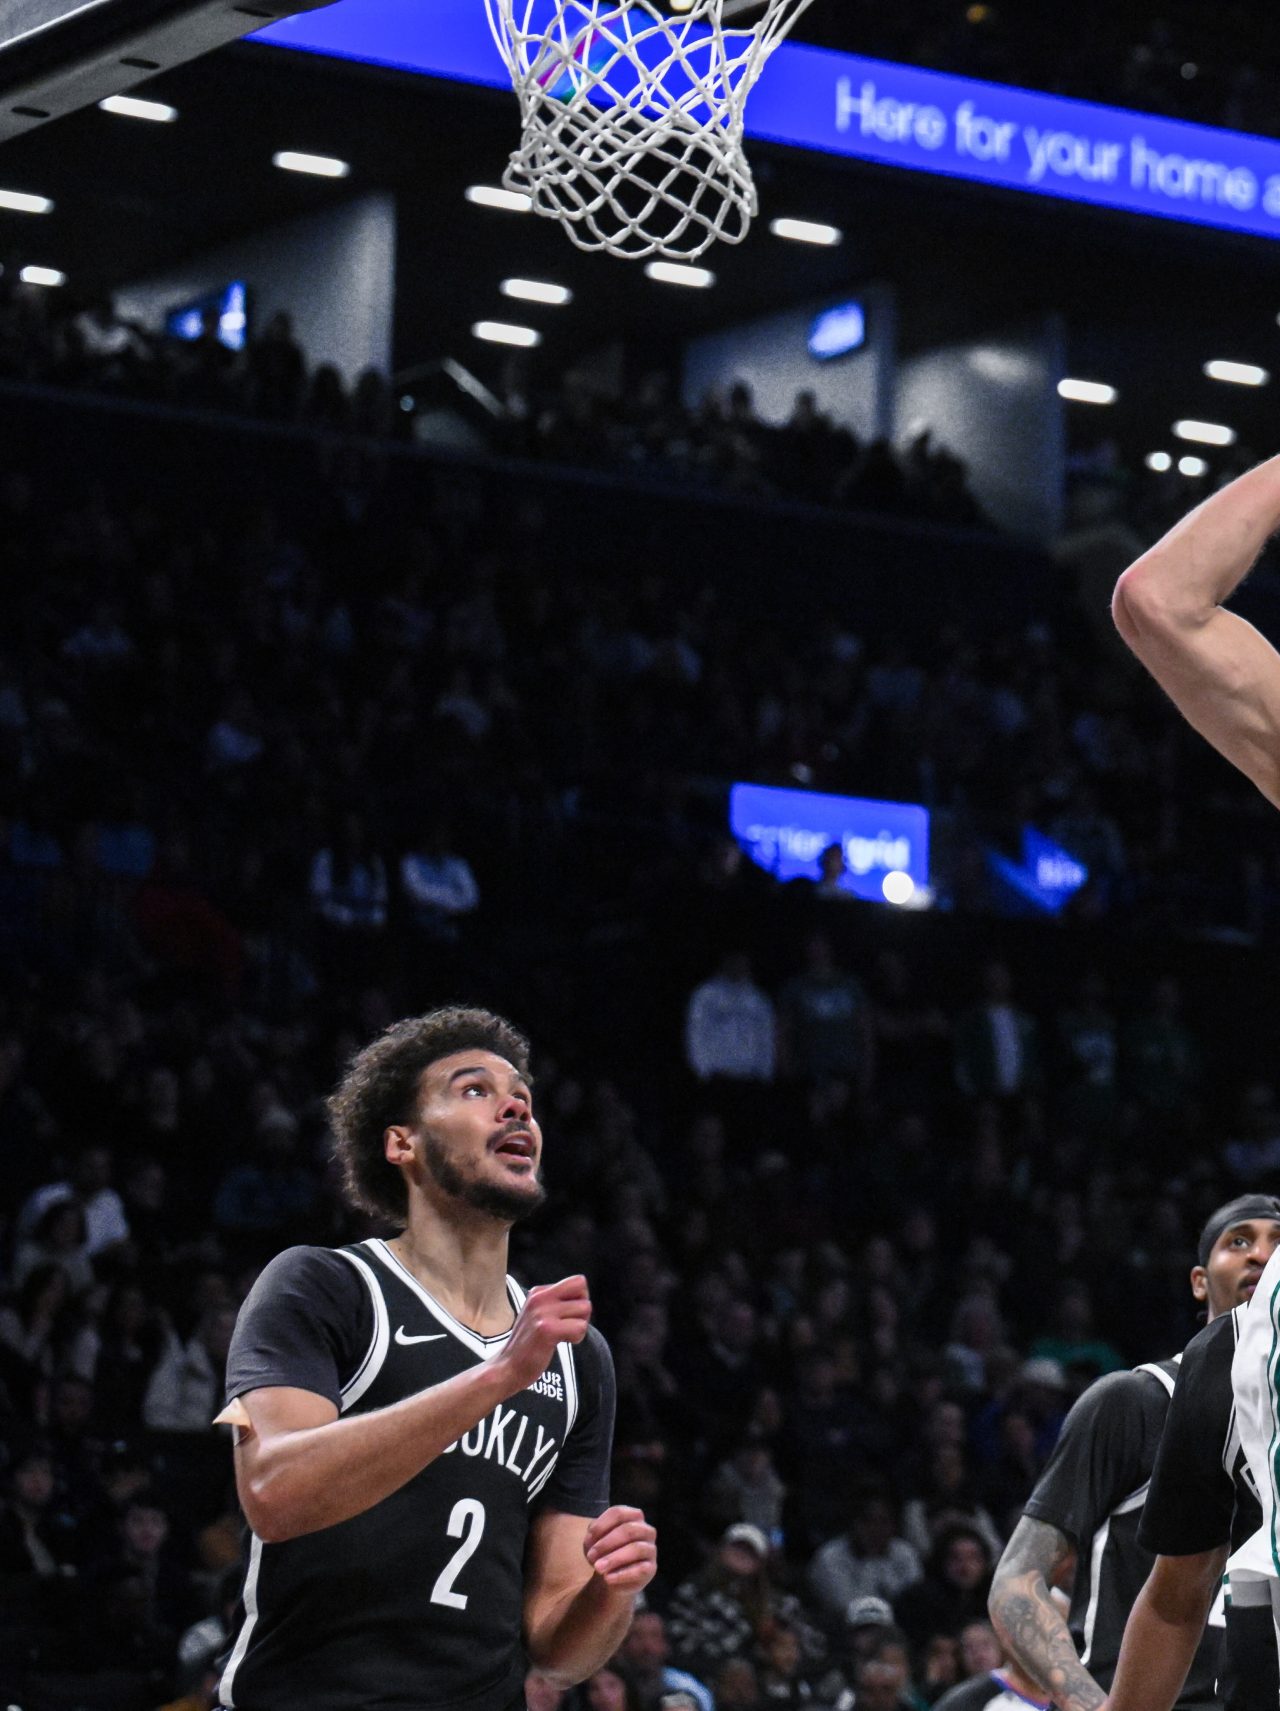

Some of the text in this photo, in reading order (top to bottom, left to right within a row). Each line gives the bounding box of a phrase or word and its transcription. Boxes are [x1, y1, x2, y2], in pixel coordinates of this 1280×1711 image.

[836, 76, 946, 150] Here
[955, 100, 1018, 163] for
[1023, 125, 1122, 183] your
[1130, 133, 1259, 212] home
[430, 1497, 486, 1610] 2
